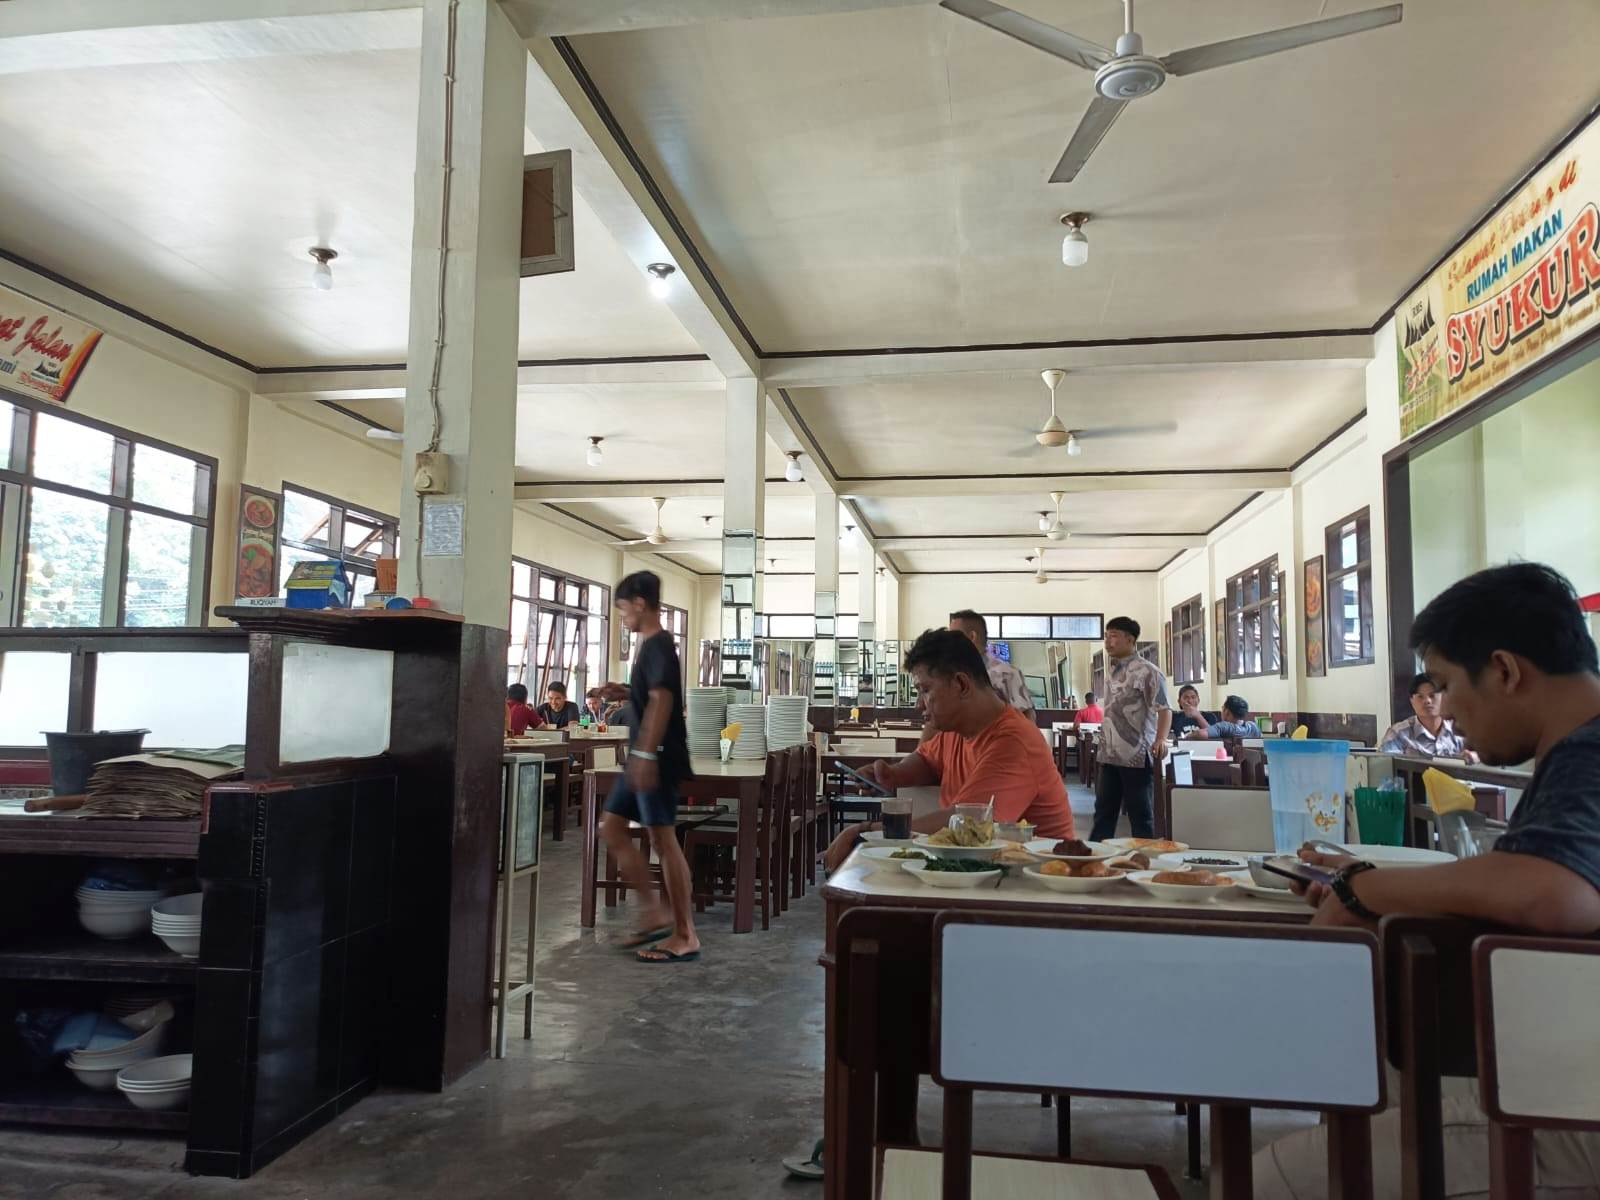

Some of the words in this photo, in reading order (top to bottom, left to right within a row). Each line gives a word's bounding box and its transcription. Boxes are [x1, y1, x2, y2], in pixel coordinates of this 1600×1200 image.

[1446, 205, 1600, 381] SYUKUR
[1466, 254, 1508, 304] RUMAH
[1511, 208, 1563, 267] MAKAN
[12, 315, 74, 362] Jalan
